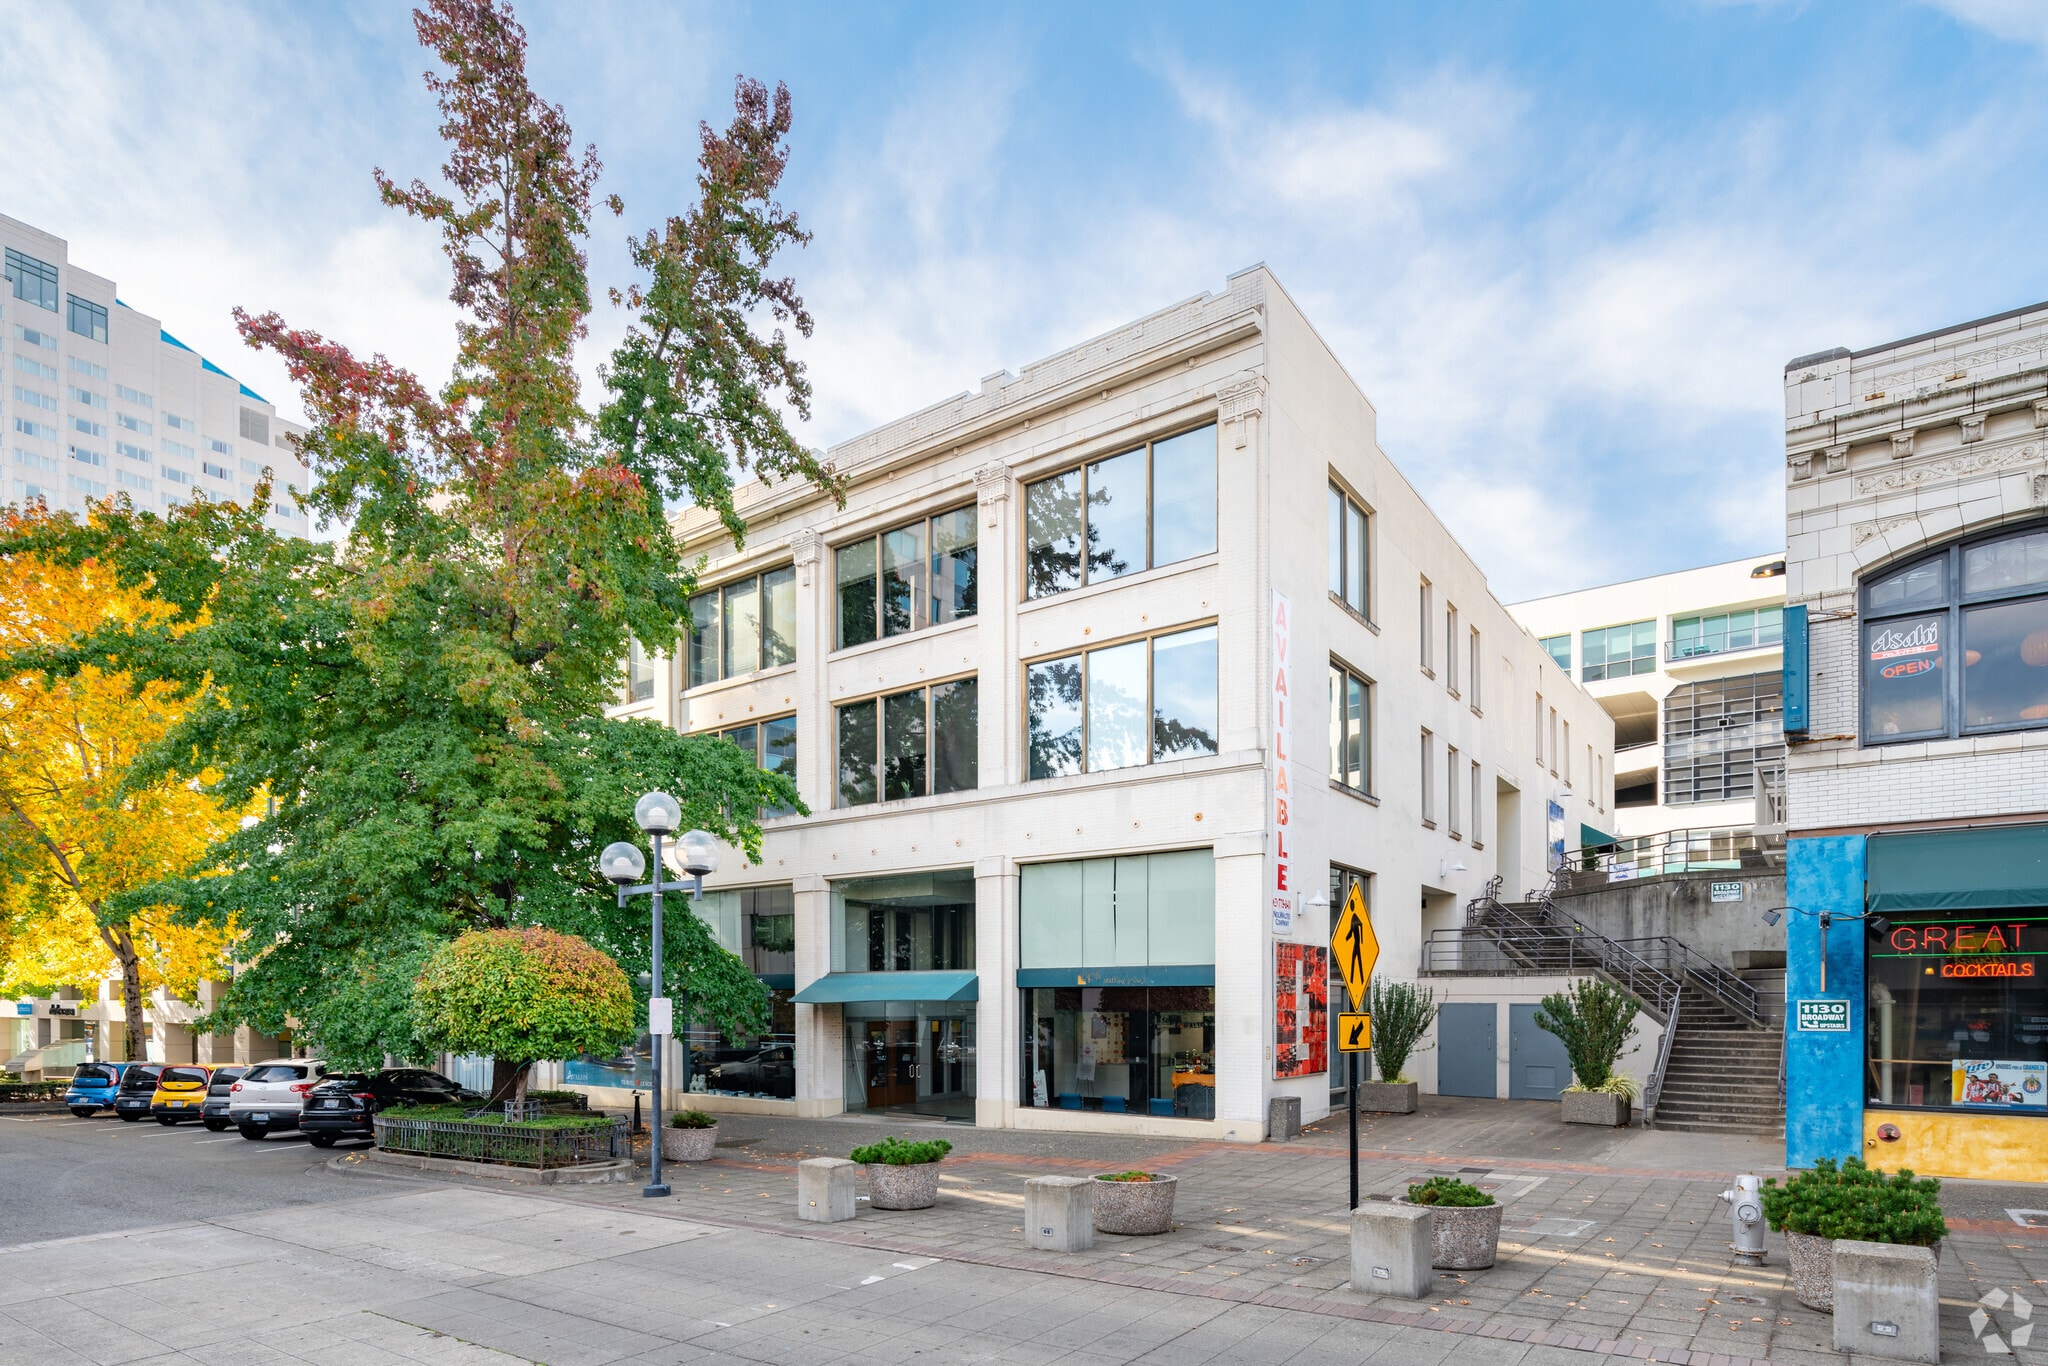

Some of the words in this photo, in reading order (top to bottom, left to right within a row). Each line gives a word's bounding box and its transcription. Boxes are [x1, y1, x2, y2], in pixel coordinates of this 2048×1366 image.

[1871, 622, 1938, 652] Asahi
[1882, 659, 1931, 678] OPEN
[1275, 601, 1289, 891] AVAILABLE
[1891, 924, 2028, 950] GREAT
[1941, 962, 2034, 977] COCKTAILS
[1802, 1004, 1845, 1013] 1130
[1966, 1062, 1990, 1074] Lite
